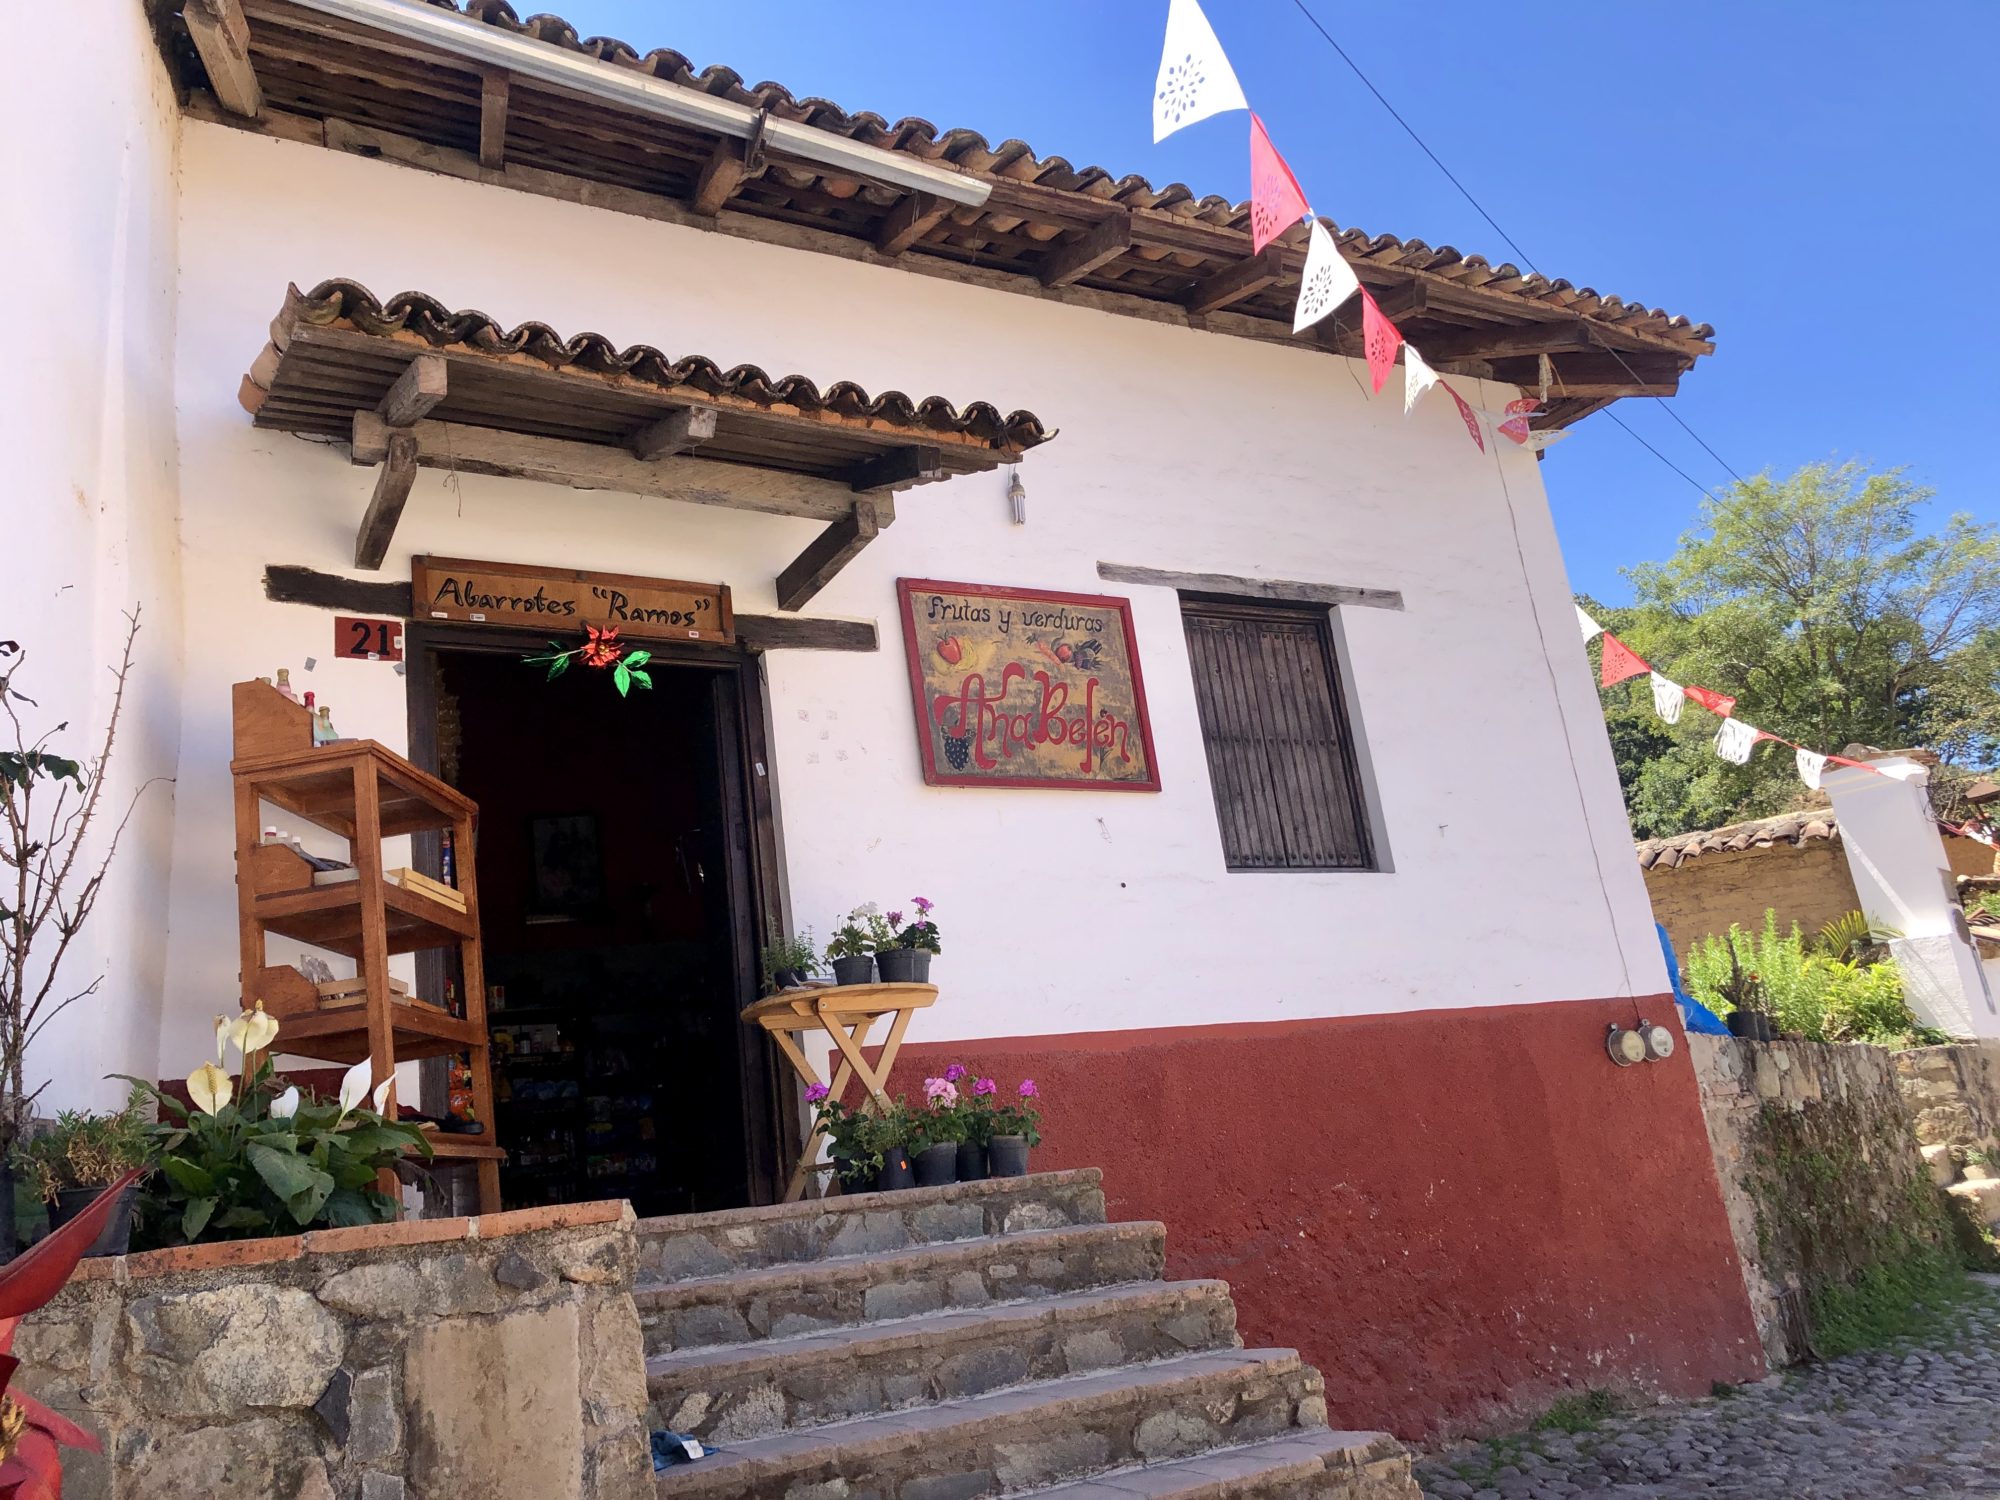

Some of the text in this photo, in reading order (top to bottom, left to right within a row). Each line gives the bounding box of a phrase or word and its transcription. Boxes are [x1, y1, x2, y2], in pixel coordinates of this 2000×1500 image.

[433, 576, 577, 617] Abarrotes
[998, 609, 1012, 634] y
[1021, 607, 1104, 633] verduras
[350, 622, 390, 656] 21
